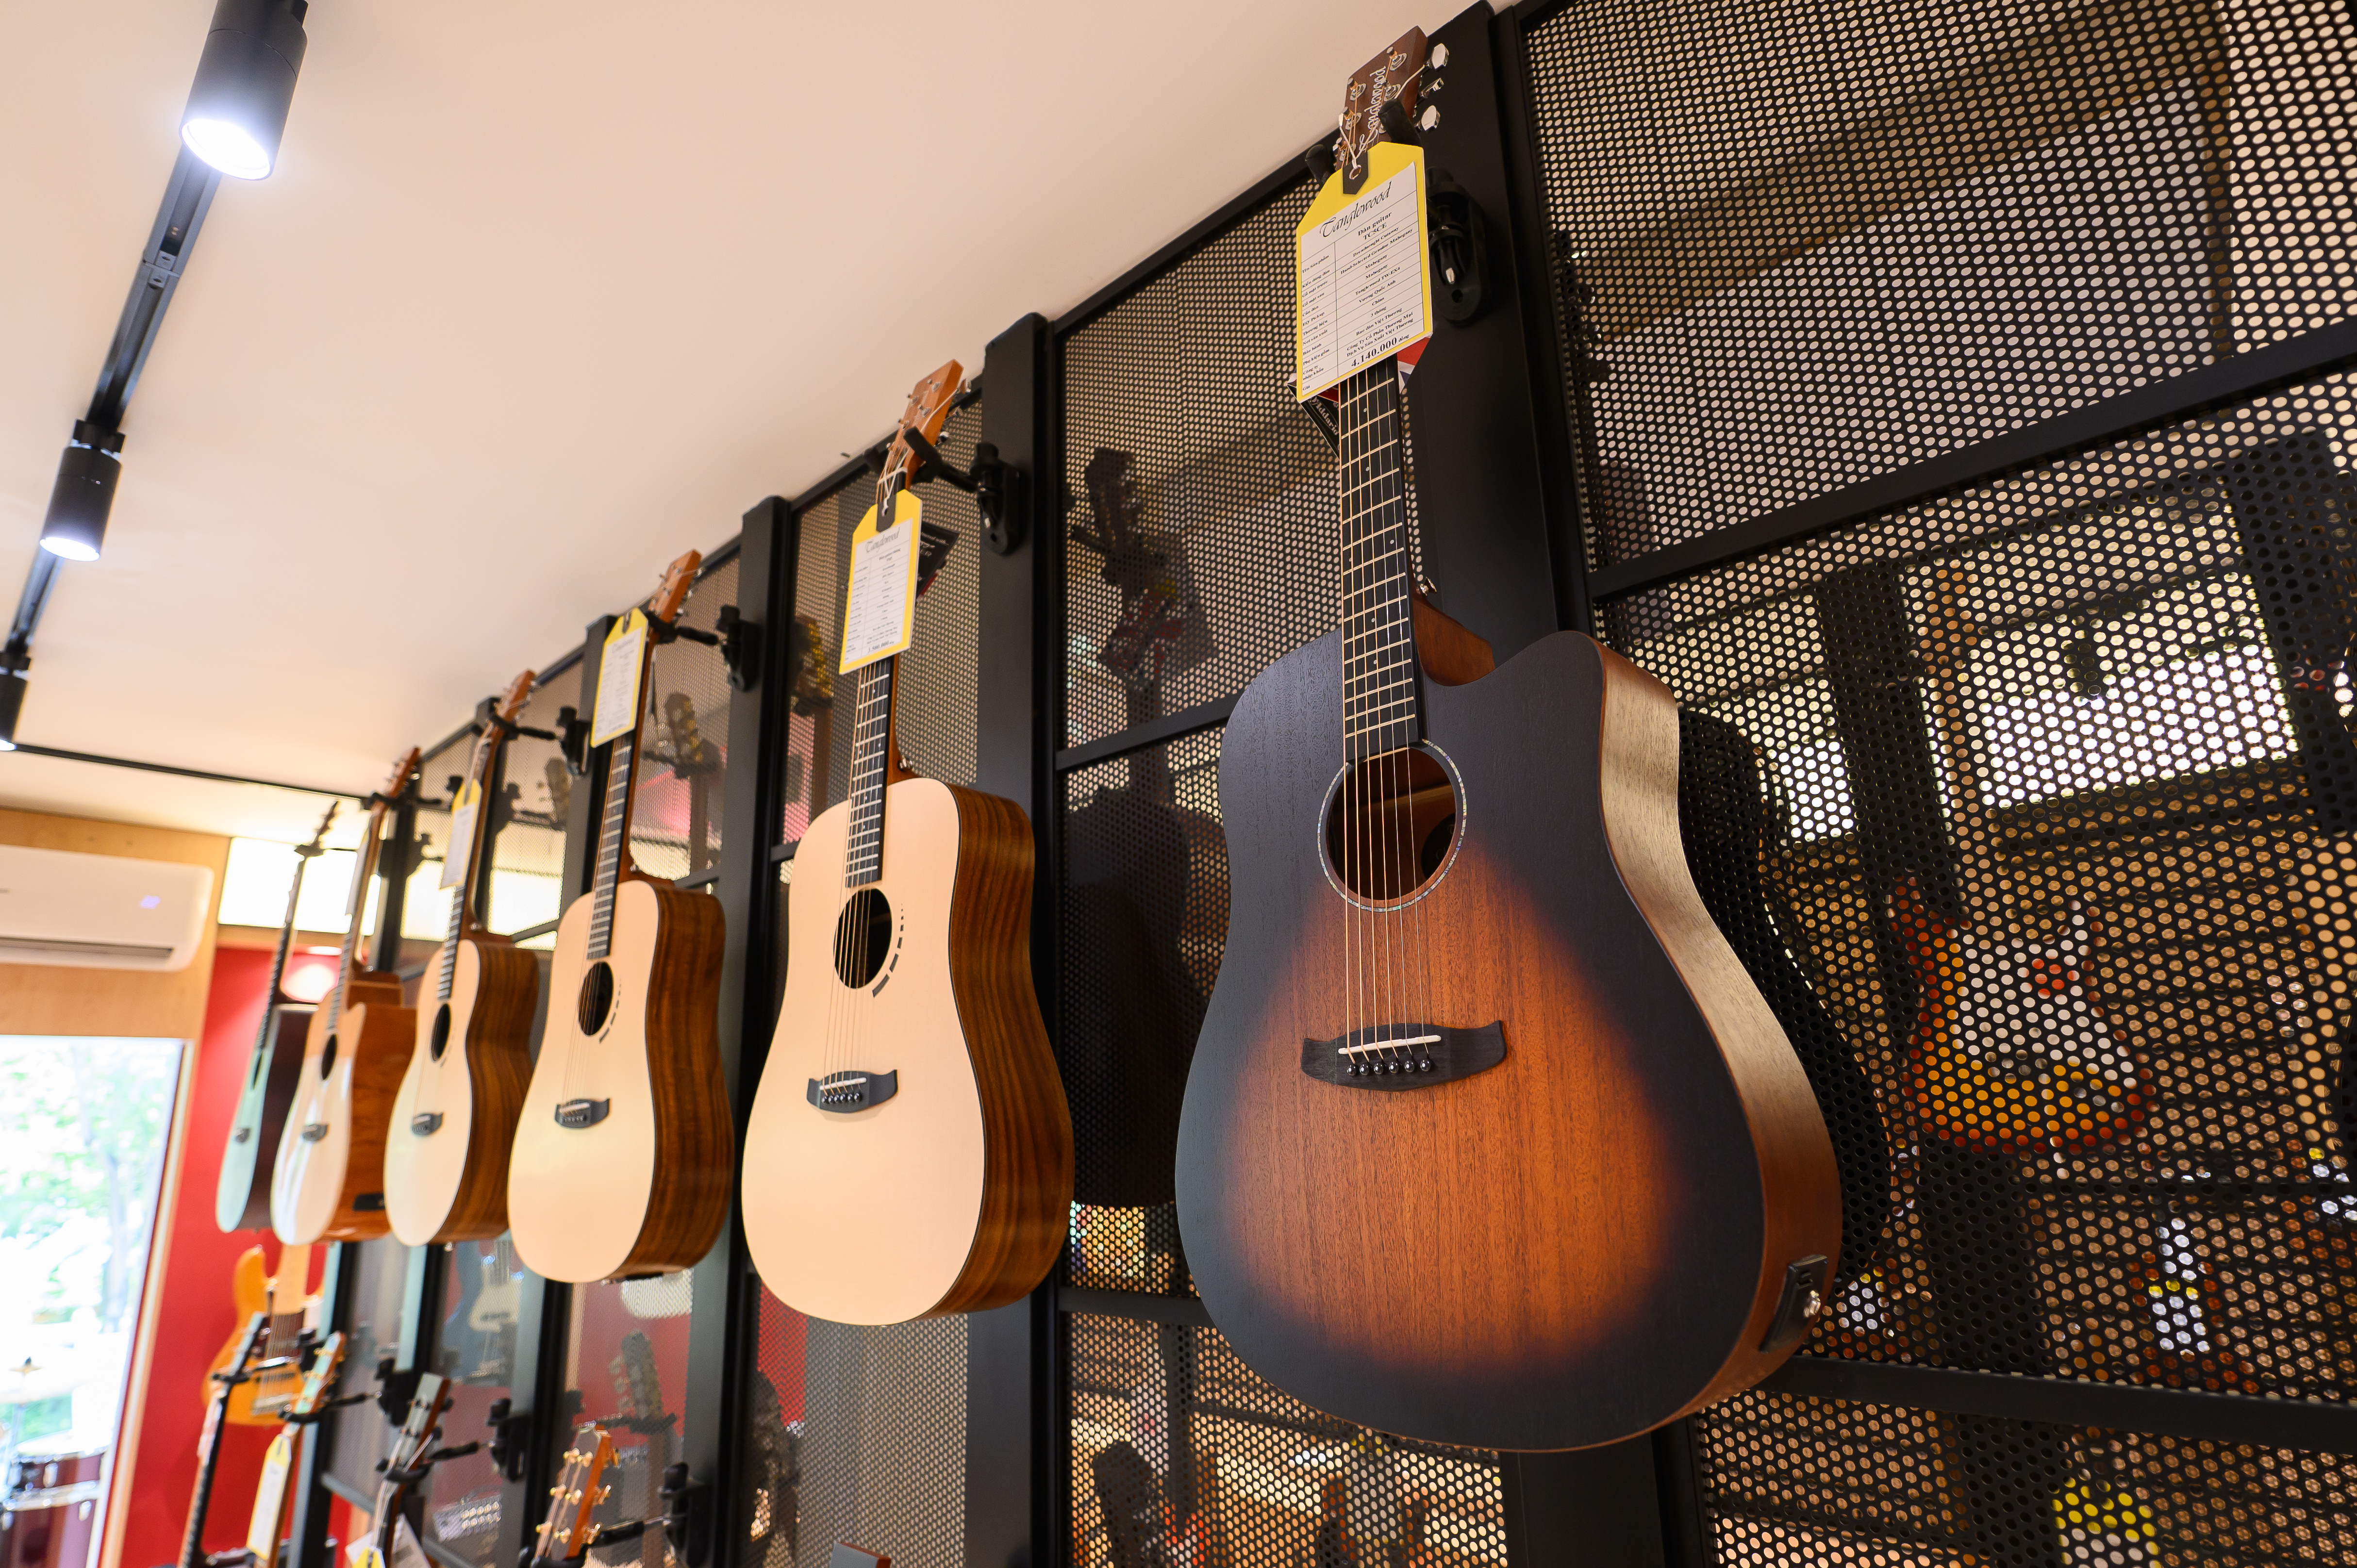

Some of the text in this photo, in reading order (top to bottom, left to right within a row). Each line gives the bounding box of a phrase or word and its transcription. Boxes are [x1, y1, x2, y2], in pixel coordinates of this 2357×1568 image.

[1320, 181, 1392, 237] Tanglewood
[1373, 212, 1392, 228] guitar
[1363, 222, 1387, 240] TC5CE
[1353, 227, 1399, 257] Dreadnought Cutaway
[1341, 229, 1412, 274] Hand-Selected Genuine Mahogany
[1365, 254, 1387, 270] Mahogany
[1366, 264, 1388, 280] Mahogany
[1355, 278, 1380, 295] Tanglewood
[1352, 338, 1396, 366] 4.140.000
